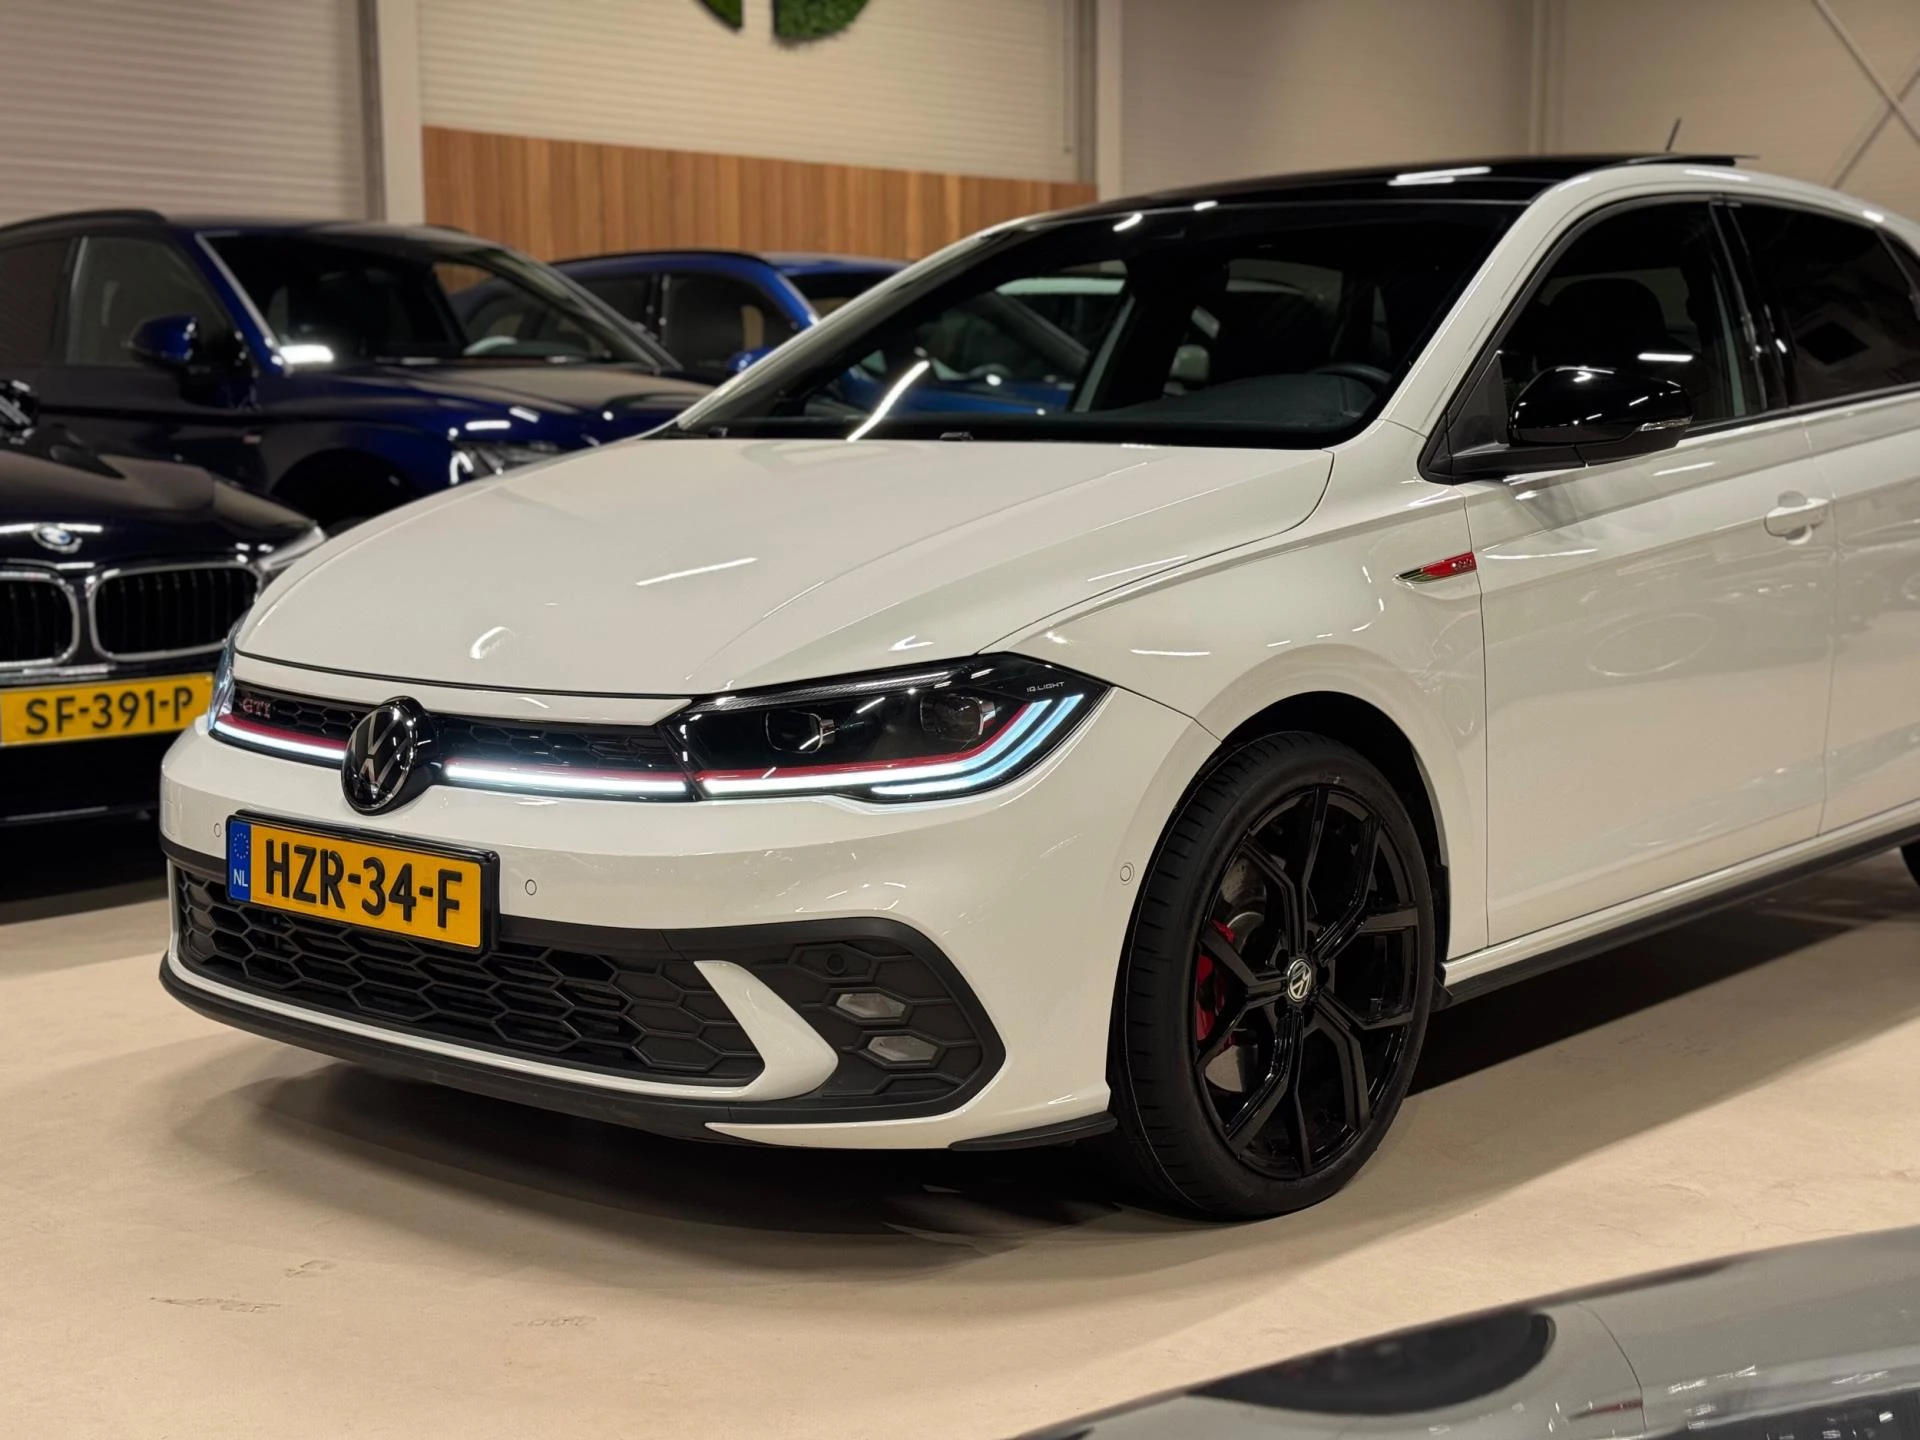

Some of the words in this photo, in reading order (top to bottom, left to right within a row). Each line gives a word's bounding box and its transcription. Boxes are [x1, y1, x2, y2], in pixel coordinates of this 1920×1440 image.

[25, 686, 194, 736] SF-391-P
[242, 697, 271, 719] GTI
[233, 868, 249, 888] NL
[265, 838, 463, 929] HZR-34-F
